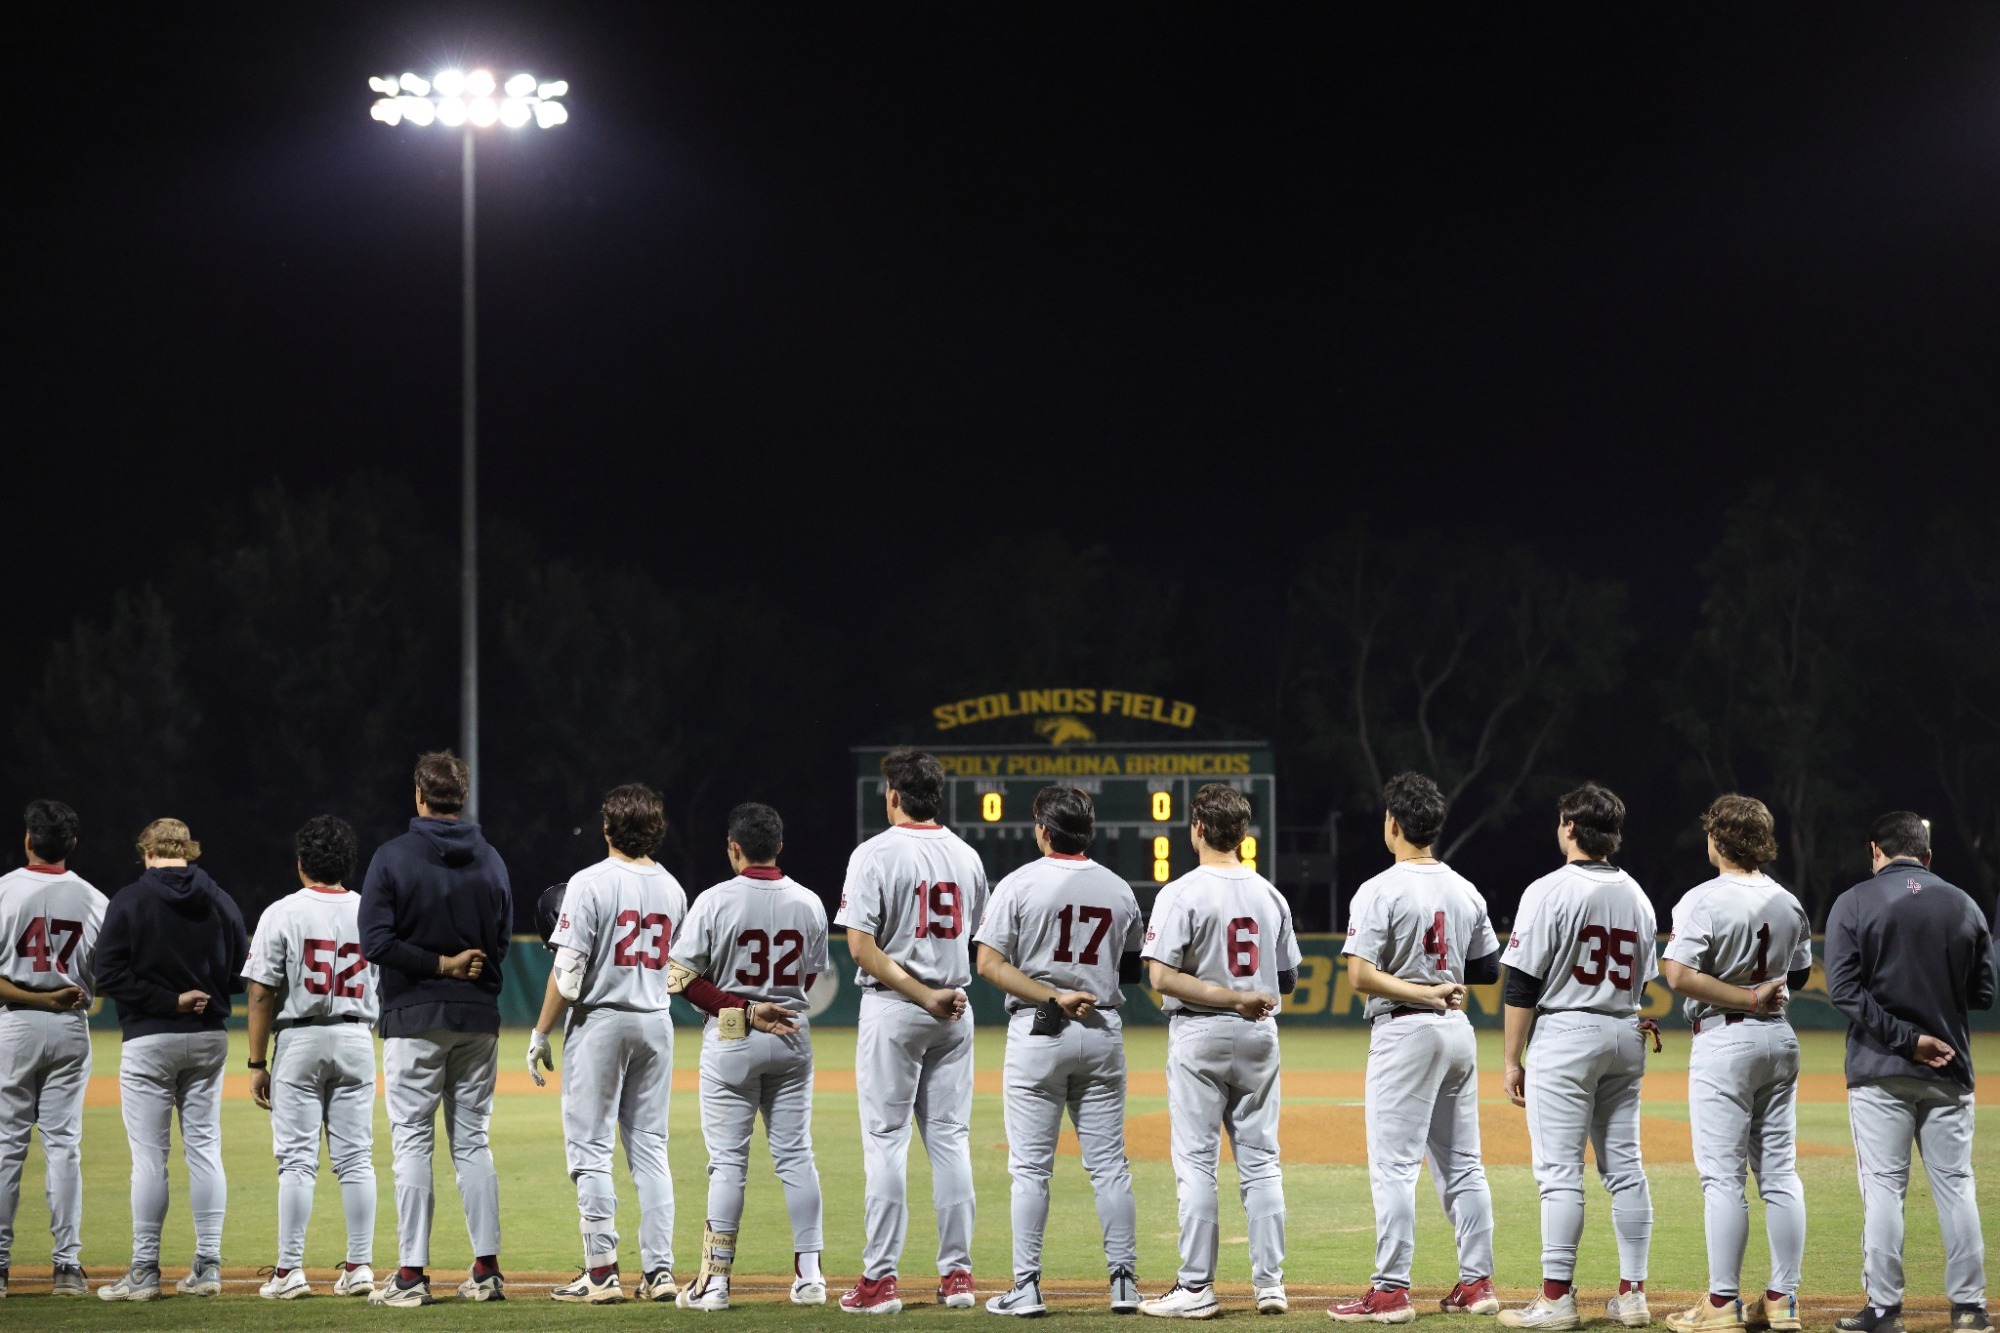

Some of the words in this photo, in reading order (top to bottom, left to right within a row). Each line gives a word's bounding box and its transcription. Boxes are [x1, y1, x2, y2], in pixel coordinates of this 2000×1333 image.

[932, 688, 1096, 729] SCOLINOS
[1101, 689, 1196, 728] FIELD
[941, 754, 1002, 776] POLY
[1006, 754, 1121, 776] POMONA
[1124, 753, 1251, 775] BRONCOS
[982, 792, 1003, 822] 0
[1151, 791, 1172, 821] 0
[1153, 835, 1170, 859] 0
[1153, 859, 1170, 882] 0
[1241, 835, 1257, 859] 0
[614, 909, 674, 970] 23
[915, 881, 963, 940] 19
[1053, 904, 1113, 966] 17
[16, 916, 83, 975] 47
[303, 939, 369, 999] 52
[736, 929, 804, 987] 32
[1228, 918, 1259, 978] 6
[1423, 911, 1449, 971] 4
[1571, 925, 1638, 990] 35
[1749, 923, 1770, 982] 1
